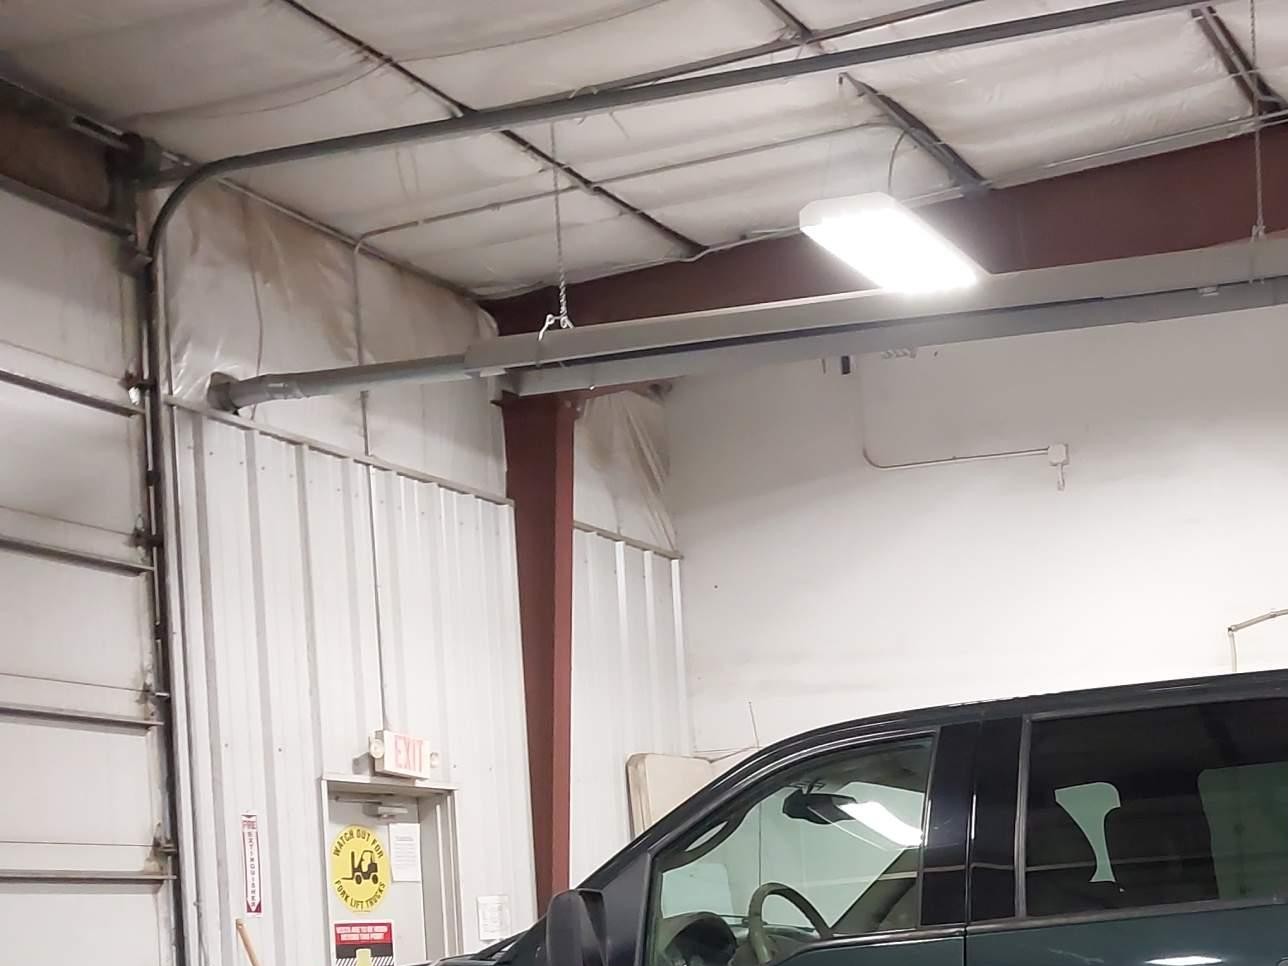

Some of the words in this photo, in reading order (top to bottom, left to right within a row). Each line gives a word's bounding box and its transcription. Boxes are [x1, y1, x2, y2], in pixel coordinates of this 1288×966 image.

[394, 735, 423, 773] EXIT
[333, 829, 355, 857] WATCH
[356, 829, 371, 842] OUT
[369, 838, 384, 859] FOR
[334, 880, 350, 903] FORK
[350, 898, 364, 910] LIFT
[366, 882, 386, 908] TRUCKS
